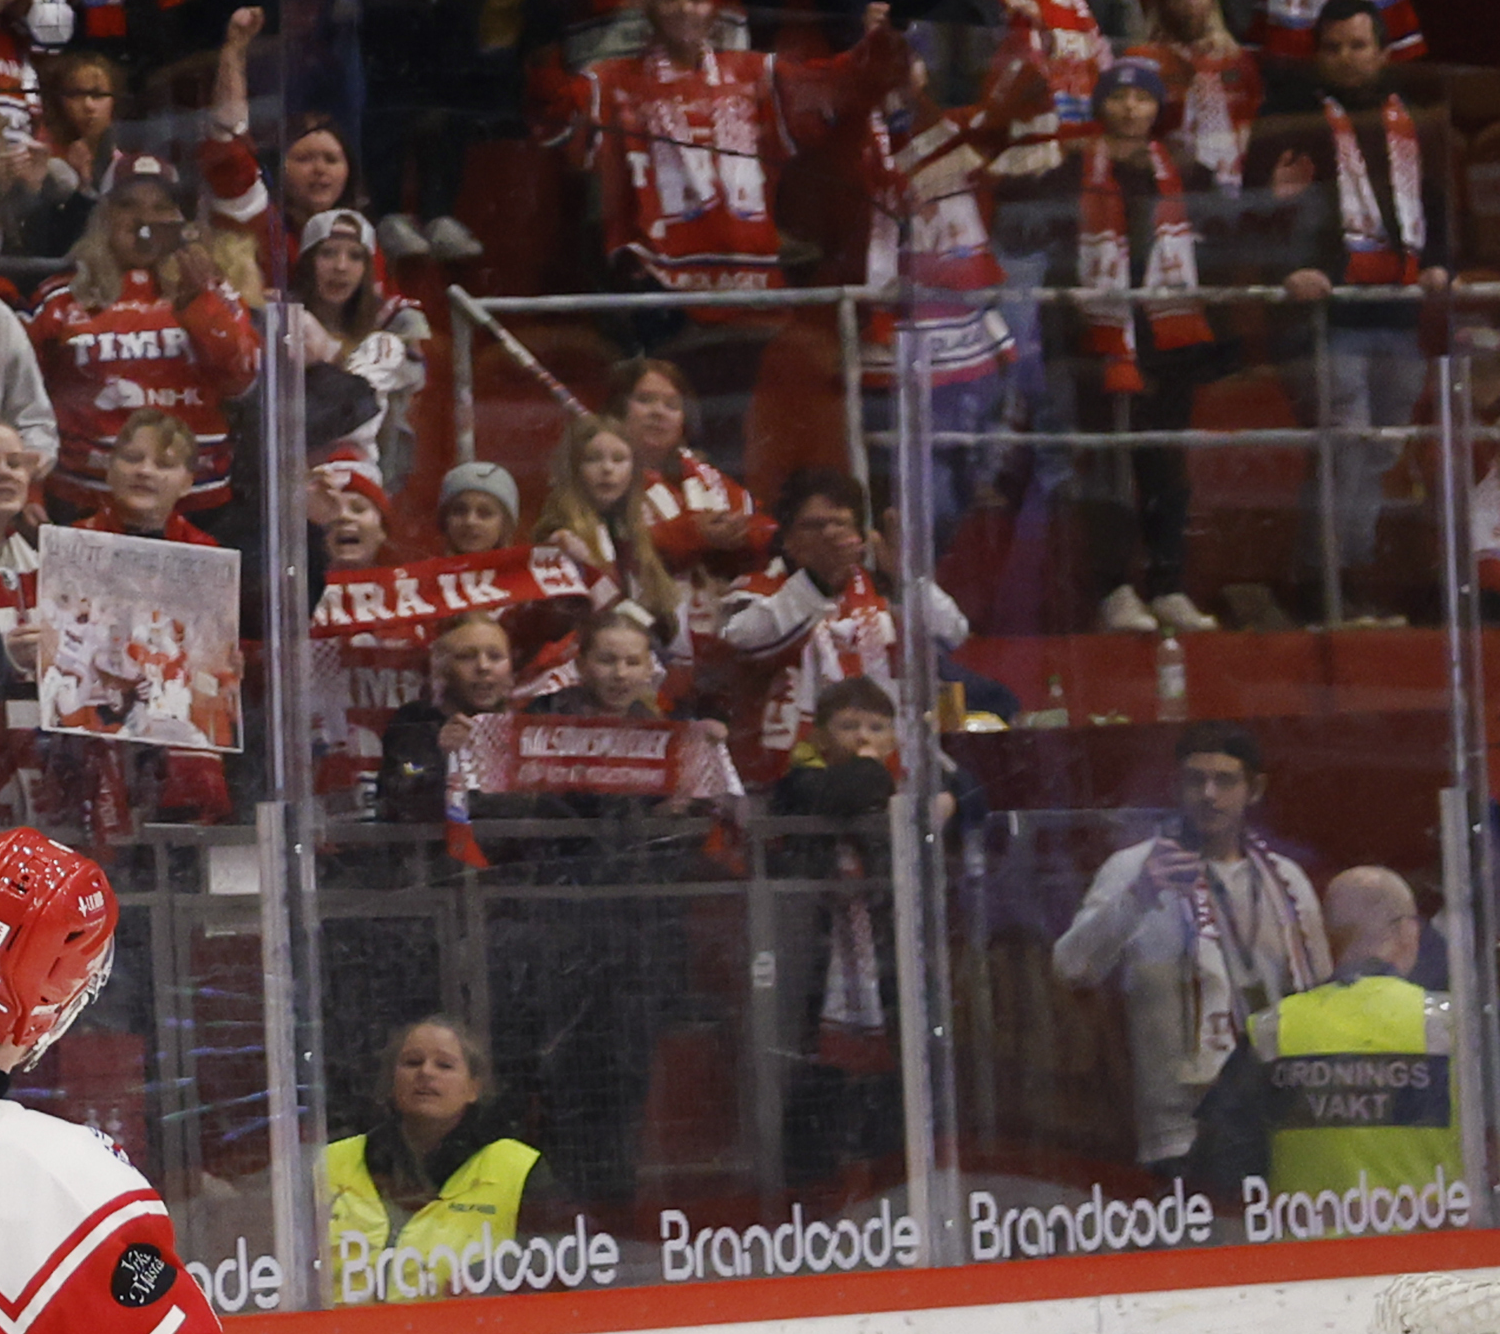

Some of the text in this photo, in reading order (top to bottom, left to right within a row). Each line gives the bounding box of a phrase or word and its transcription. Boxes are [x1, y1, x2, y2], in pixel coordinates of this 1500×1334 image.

[67, 326, 200, 368] TIMR
[314, 565, 511, 627] MRÅ IK
[1305, 1092, 1391, 1120] VAKT
[340, 1213, 619, 1303] Brandcode
[660, 1198, 922, 1282] Brandcode
[972, 1177, 1214, 1260] Brandcode
[1243, 1163, 1471, 1243] Brandcode
